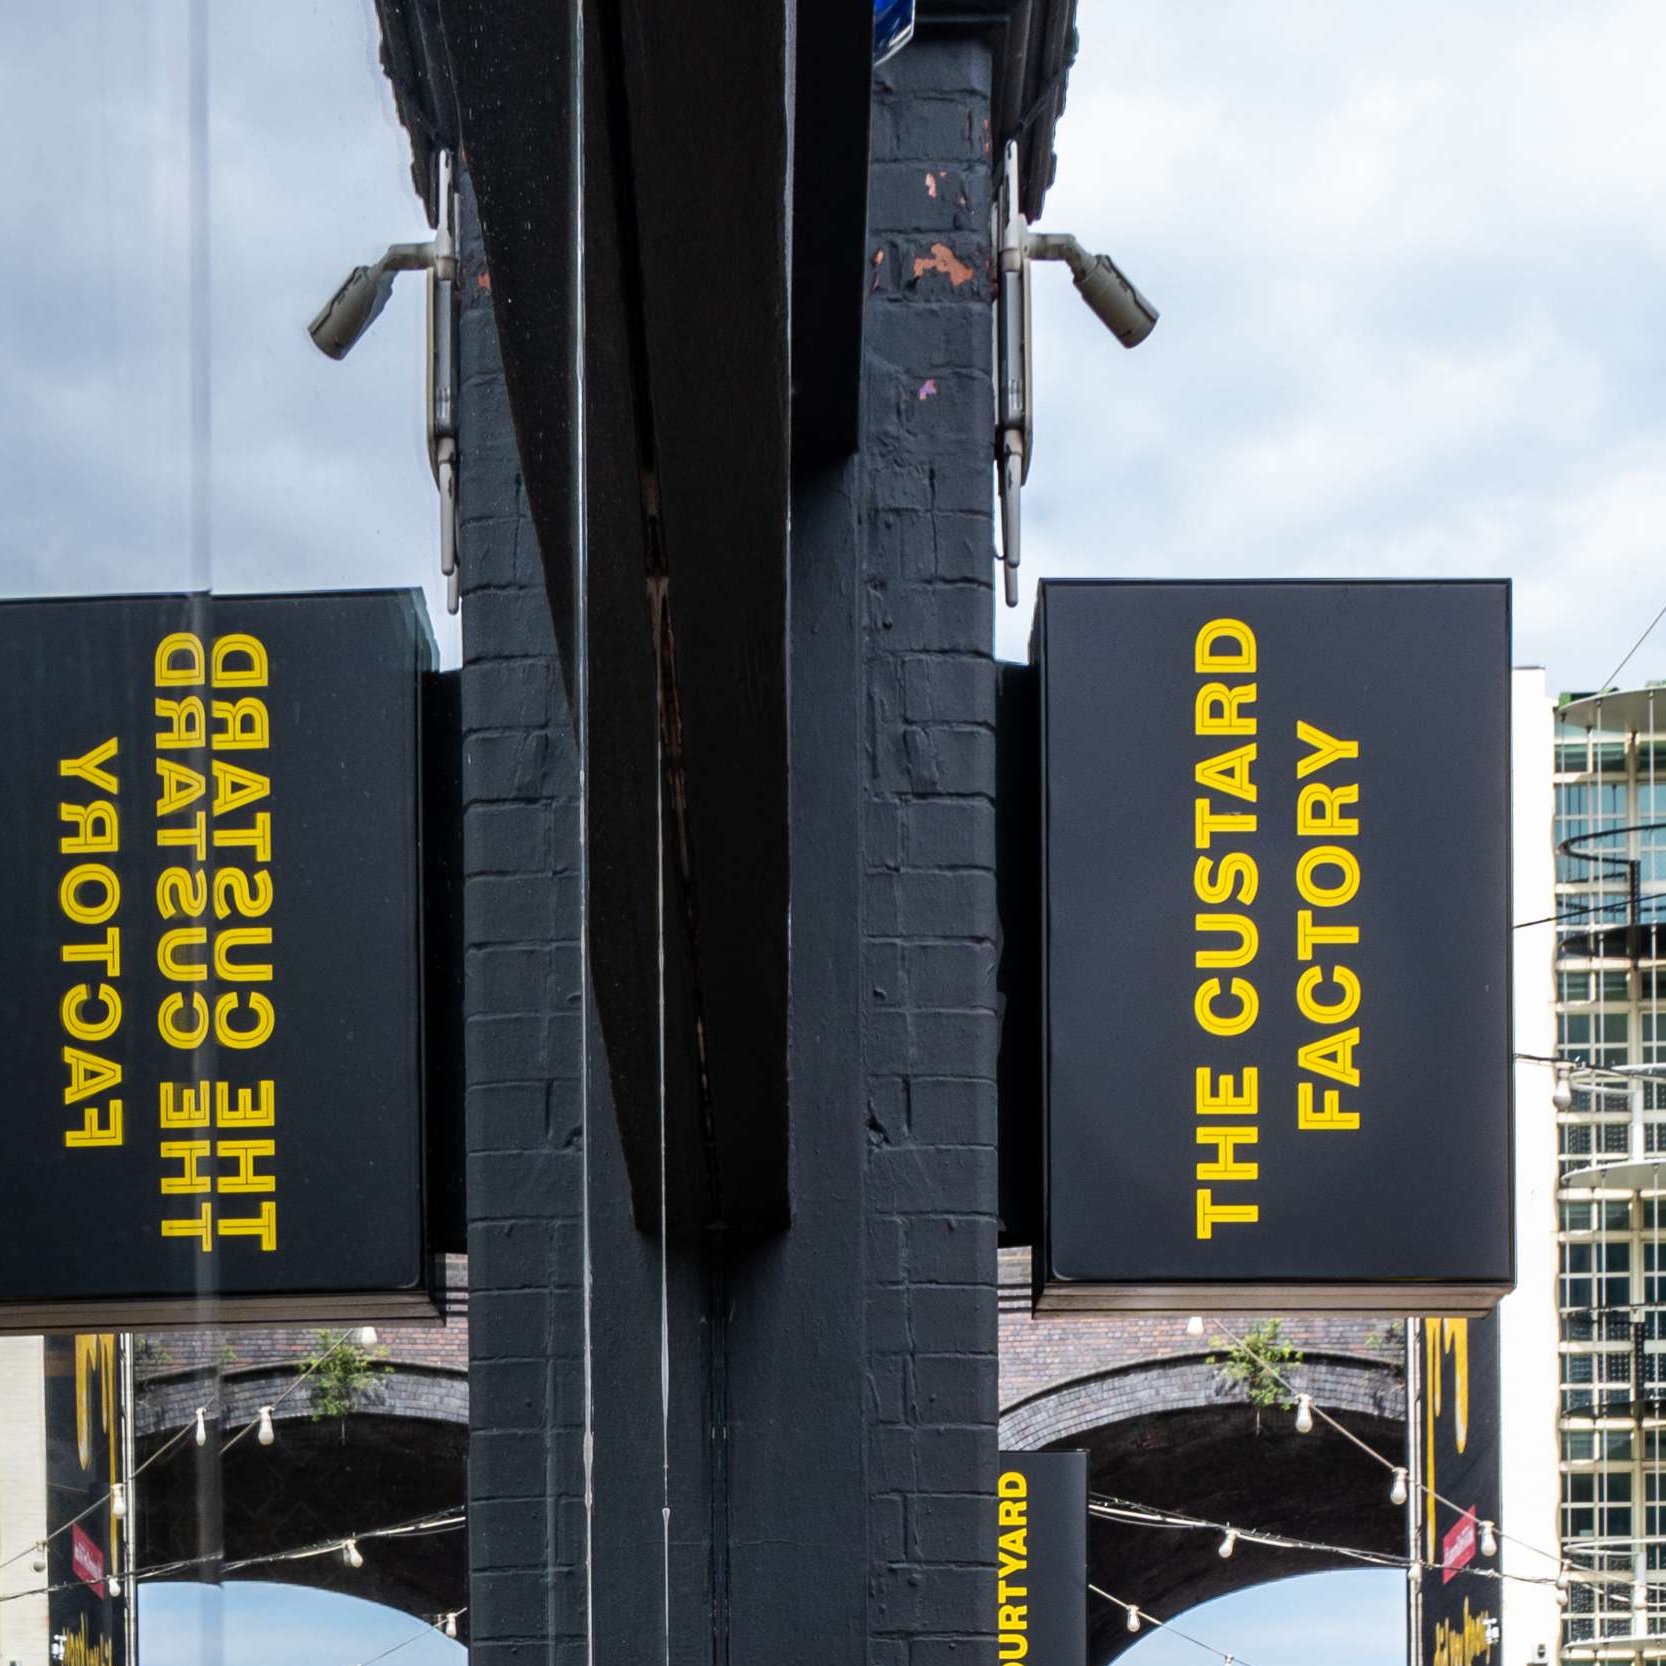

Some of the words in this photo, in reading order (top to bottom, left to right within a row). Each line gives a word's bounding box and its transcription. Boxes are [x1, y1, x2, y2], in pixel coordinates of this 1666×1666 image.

[1195, 618, 1259, 1036] CUSTARD
[1296, 720, 1361, 1130] FACTORY
[1196, 1067, 1259, 1239] THE
